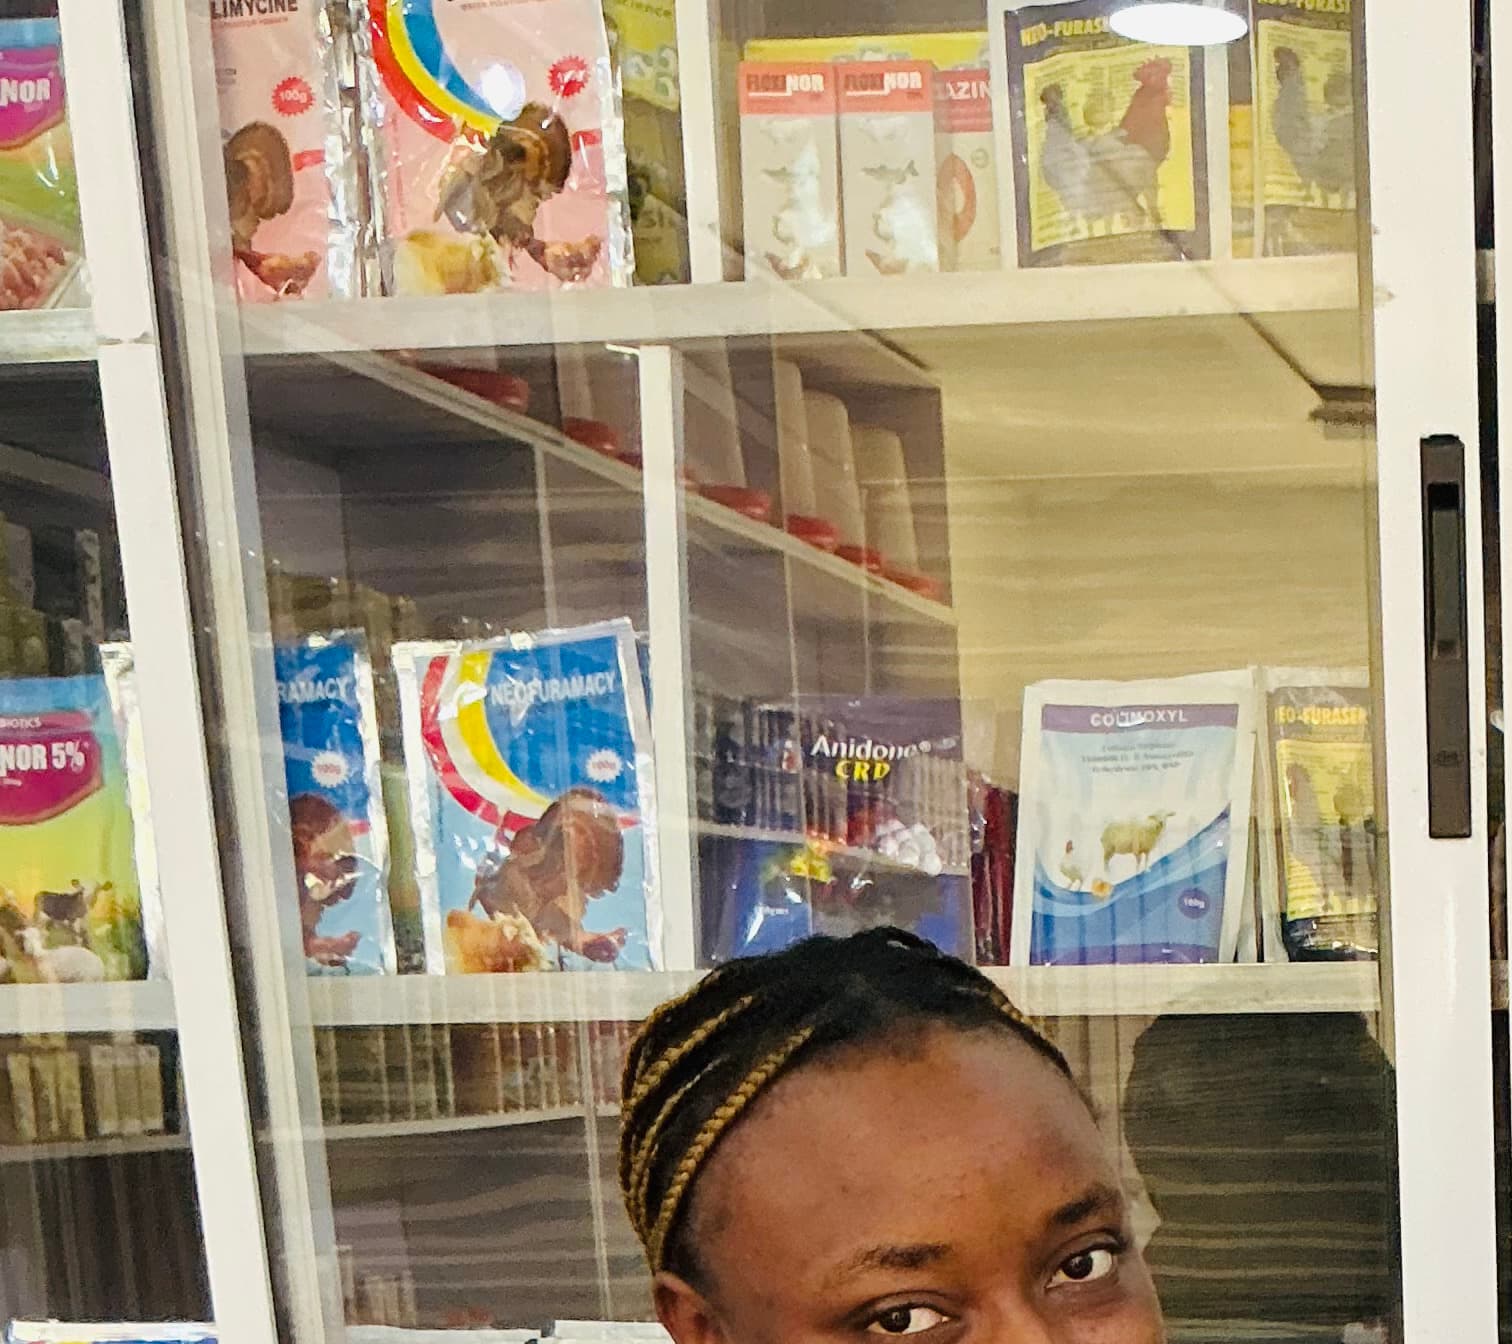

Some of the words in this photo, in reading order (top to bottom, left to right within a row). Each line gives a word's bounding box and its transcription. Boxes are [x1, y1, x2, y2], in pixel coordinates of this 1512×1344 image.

[1020, 17, 1110, 46] NEO-FURAS
[51, 742, 86, 774] 5%
[835, 759, 891, 782] CRD
